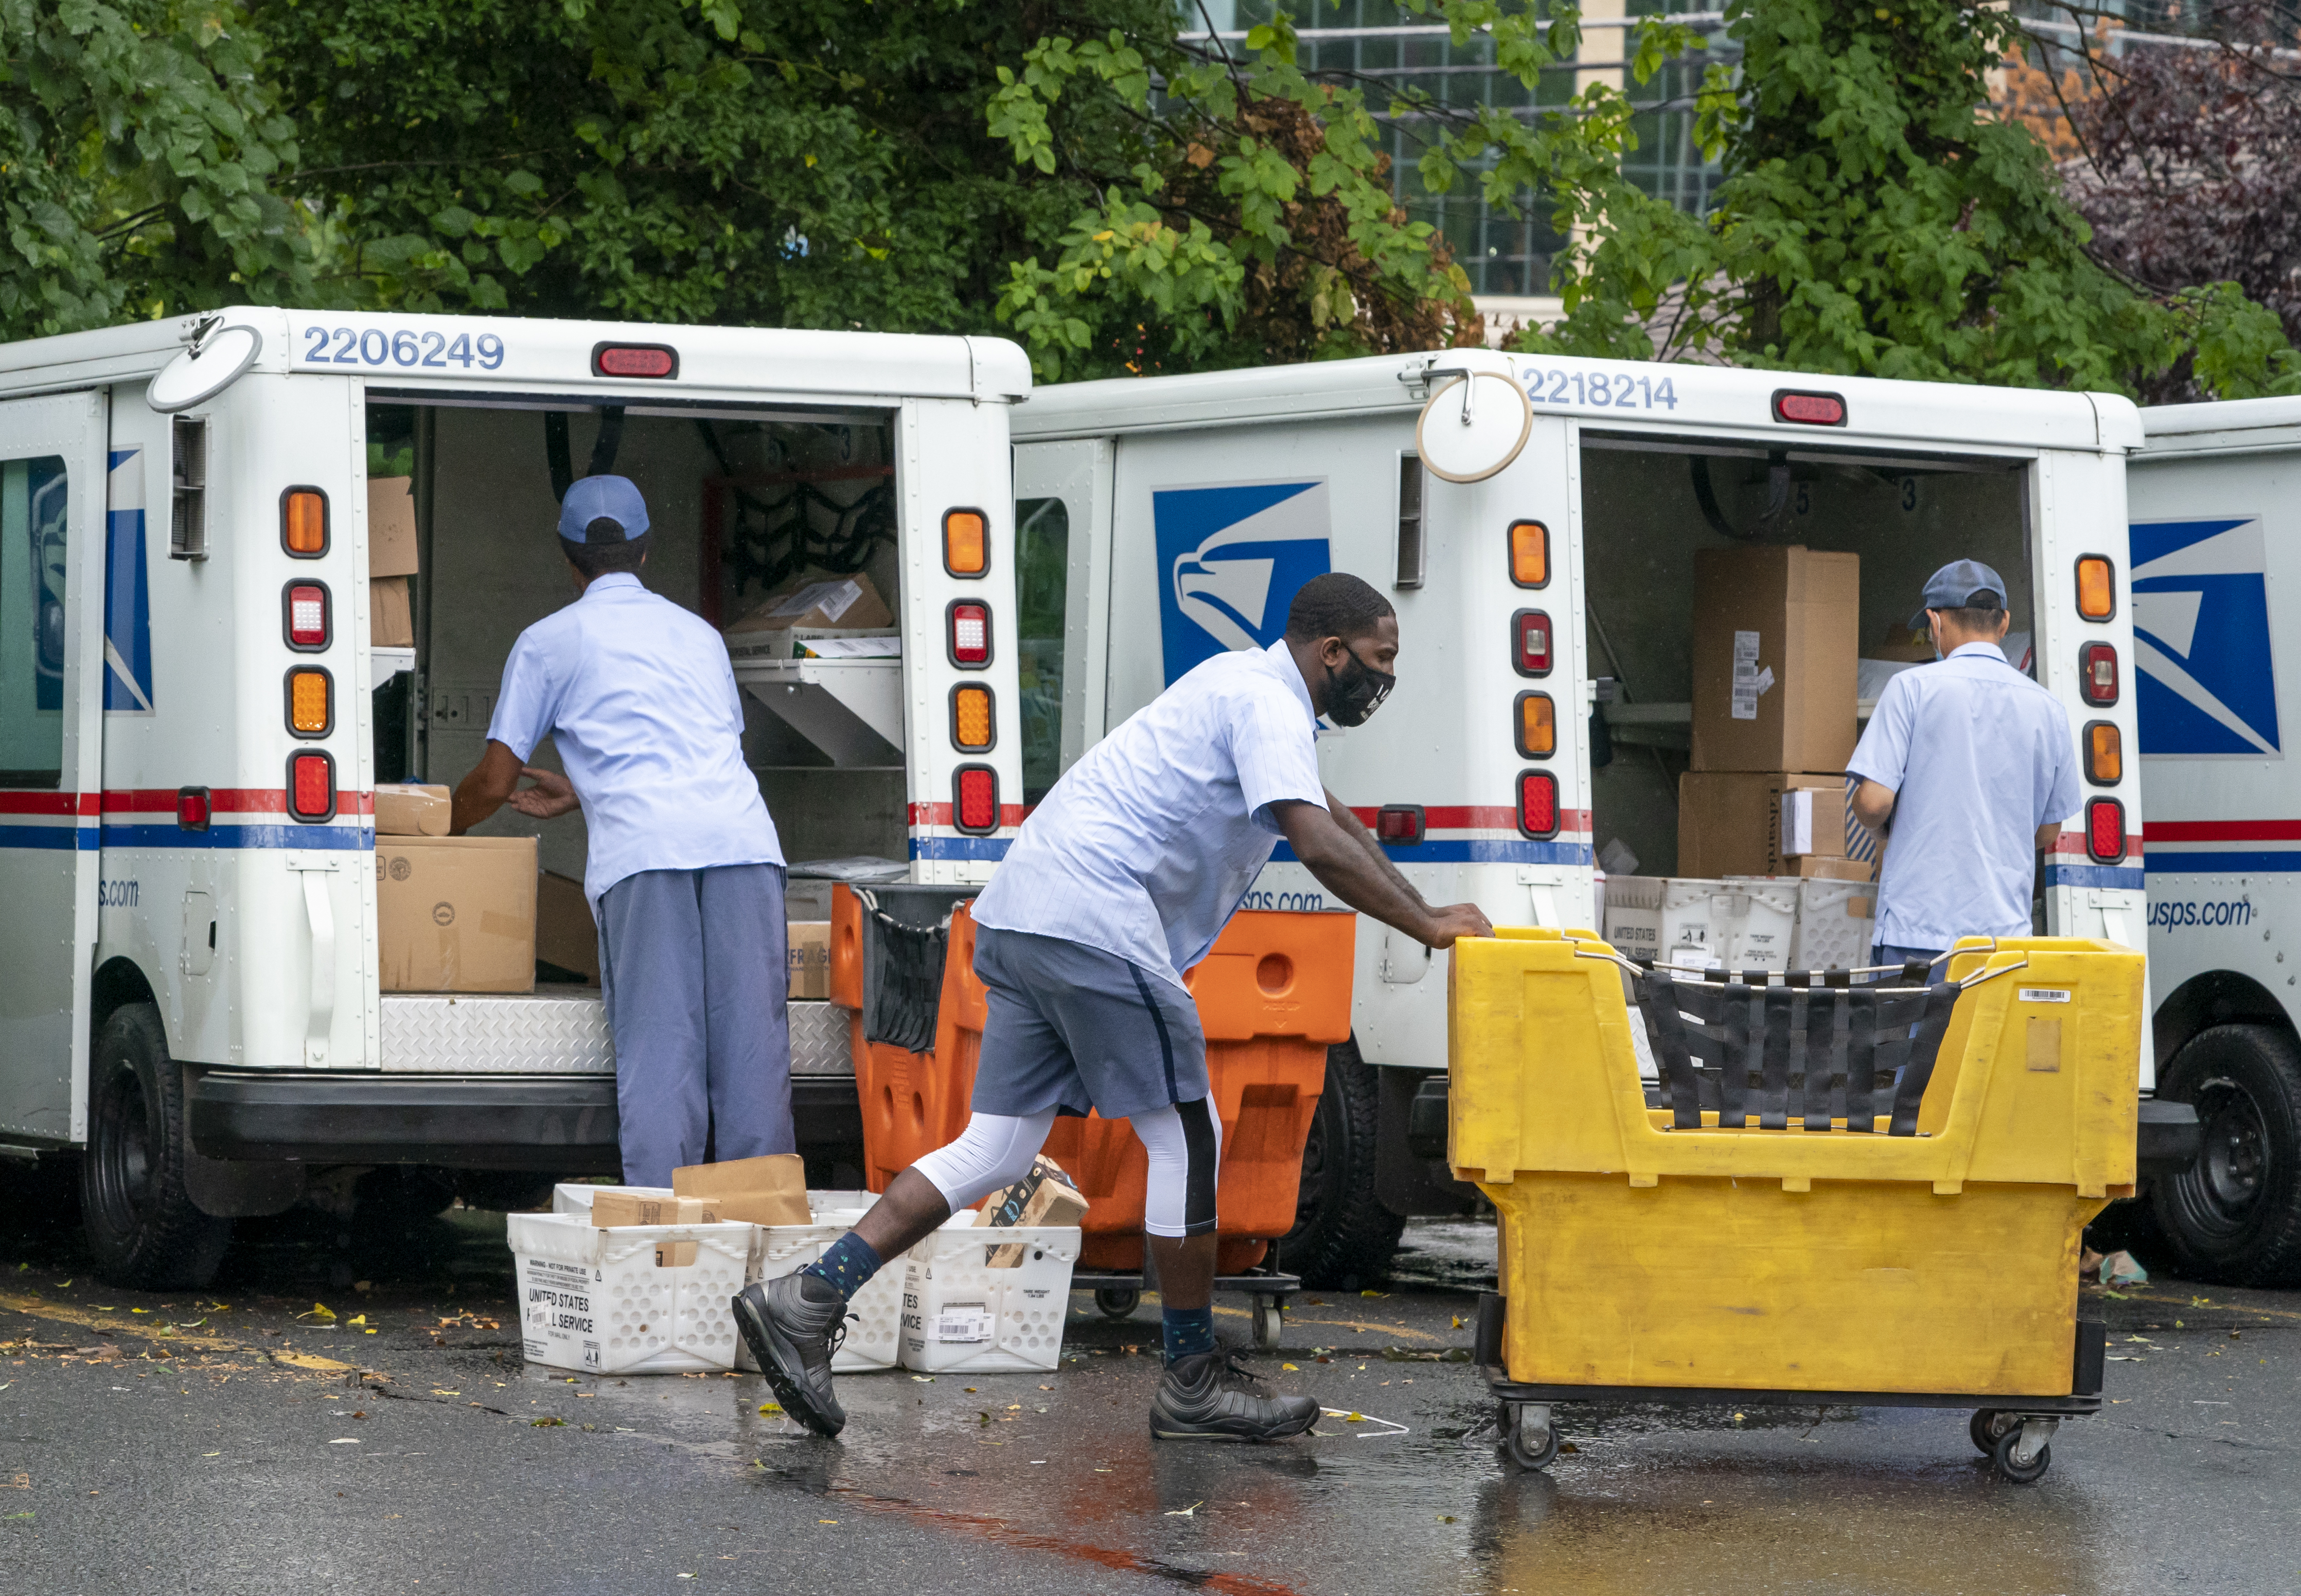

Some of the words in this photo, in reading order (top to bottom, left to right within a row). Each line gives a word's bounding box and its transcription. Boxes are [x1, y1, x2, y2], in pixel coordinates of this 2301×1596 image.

[305, 326, 504, 370] 2206249
[1523, 368, 1678, 410] 2218214
[1902, 478, 1916, 511] 3
[1767, 788, 1779, 873] Edwards
[1614, 926, 1634, 939] UNITED
[1635, 927, 1656, 942] STATES
[2147, 901, 2251, 934] usps.com
[529, 1260, 546, 1268] WARNING
[564, 1265, 578, 1274] PRIVATE
[529, 1288, 557, 1306] UNITED
[559, 1293, 589, 1312] STATES
[559, 1314, 593, 1333] SERVICE
